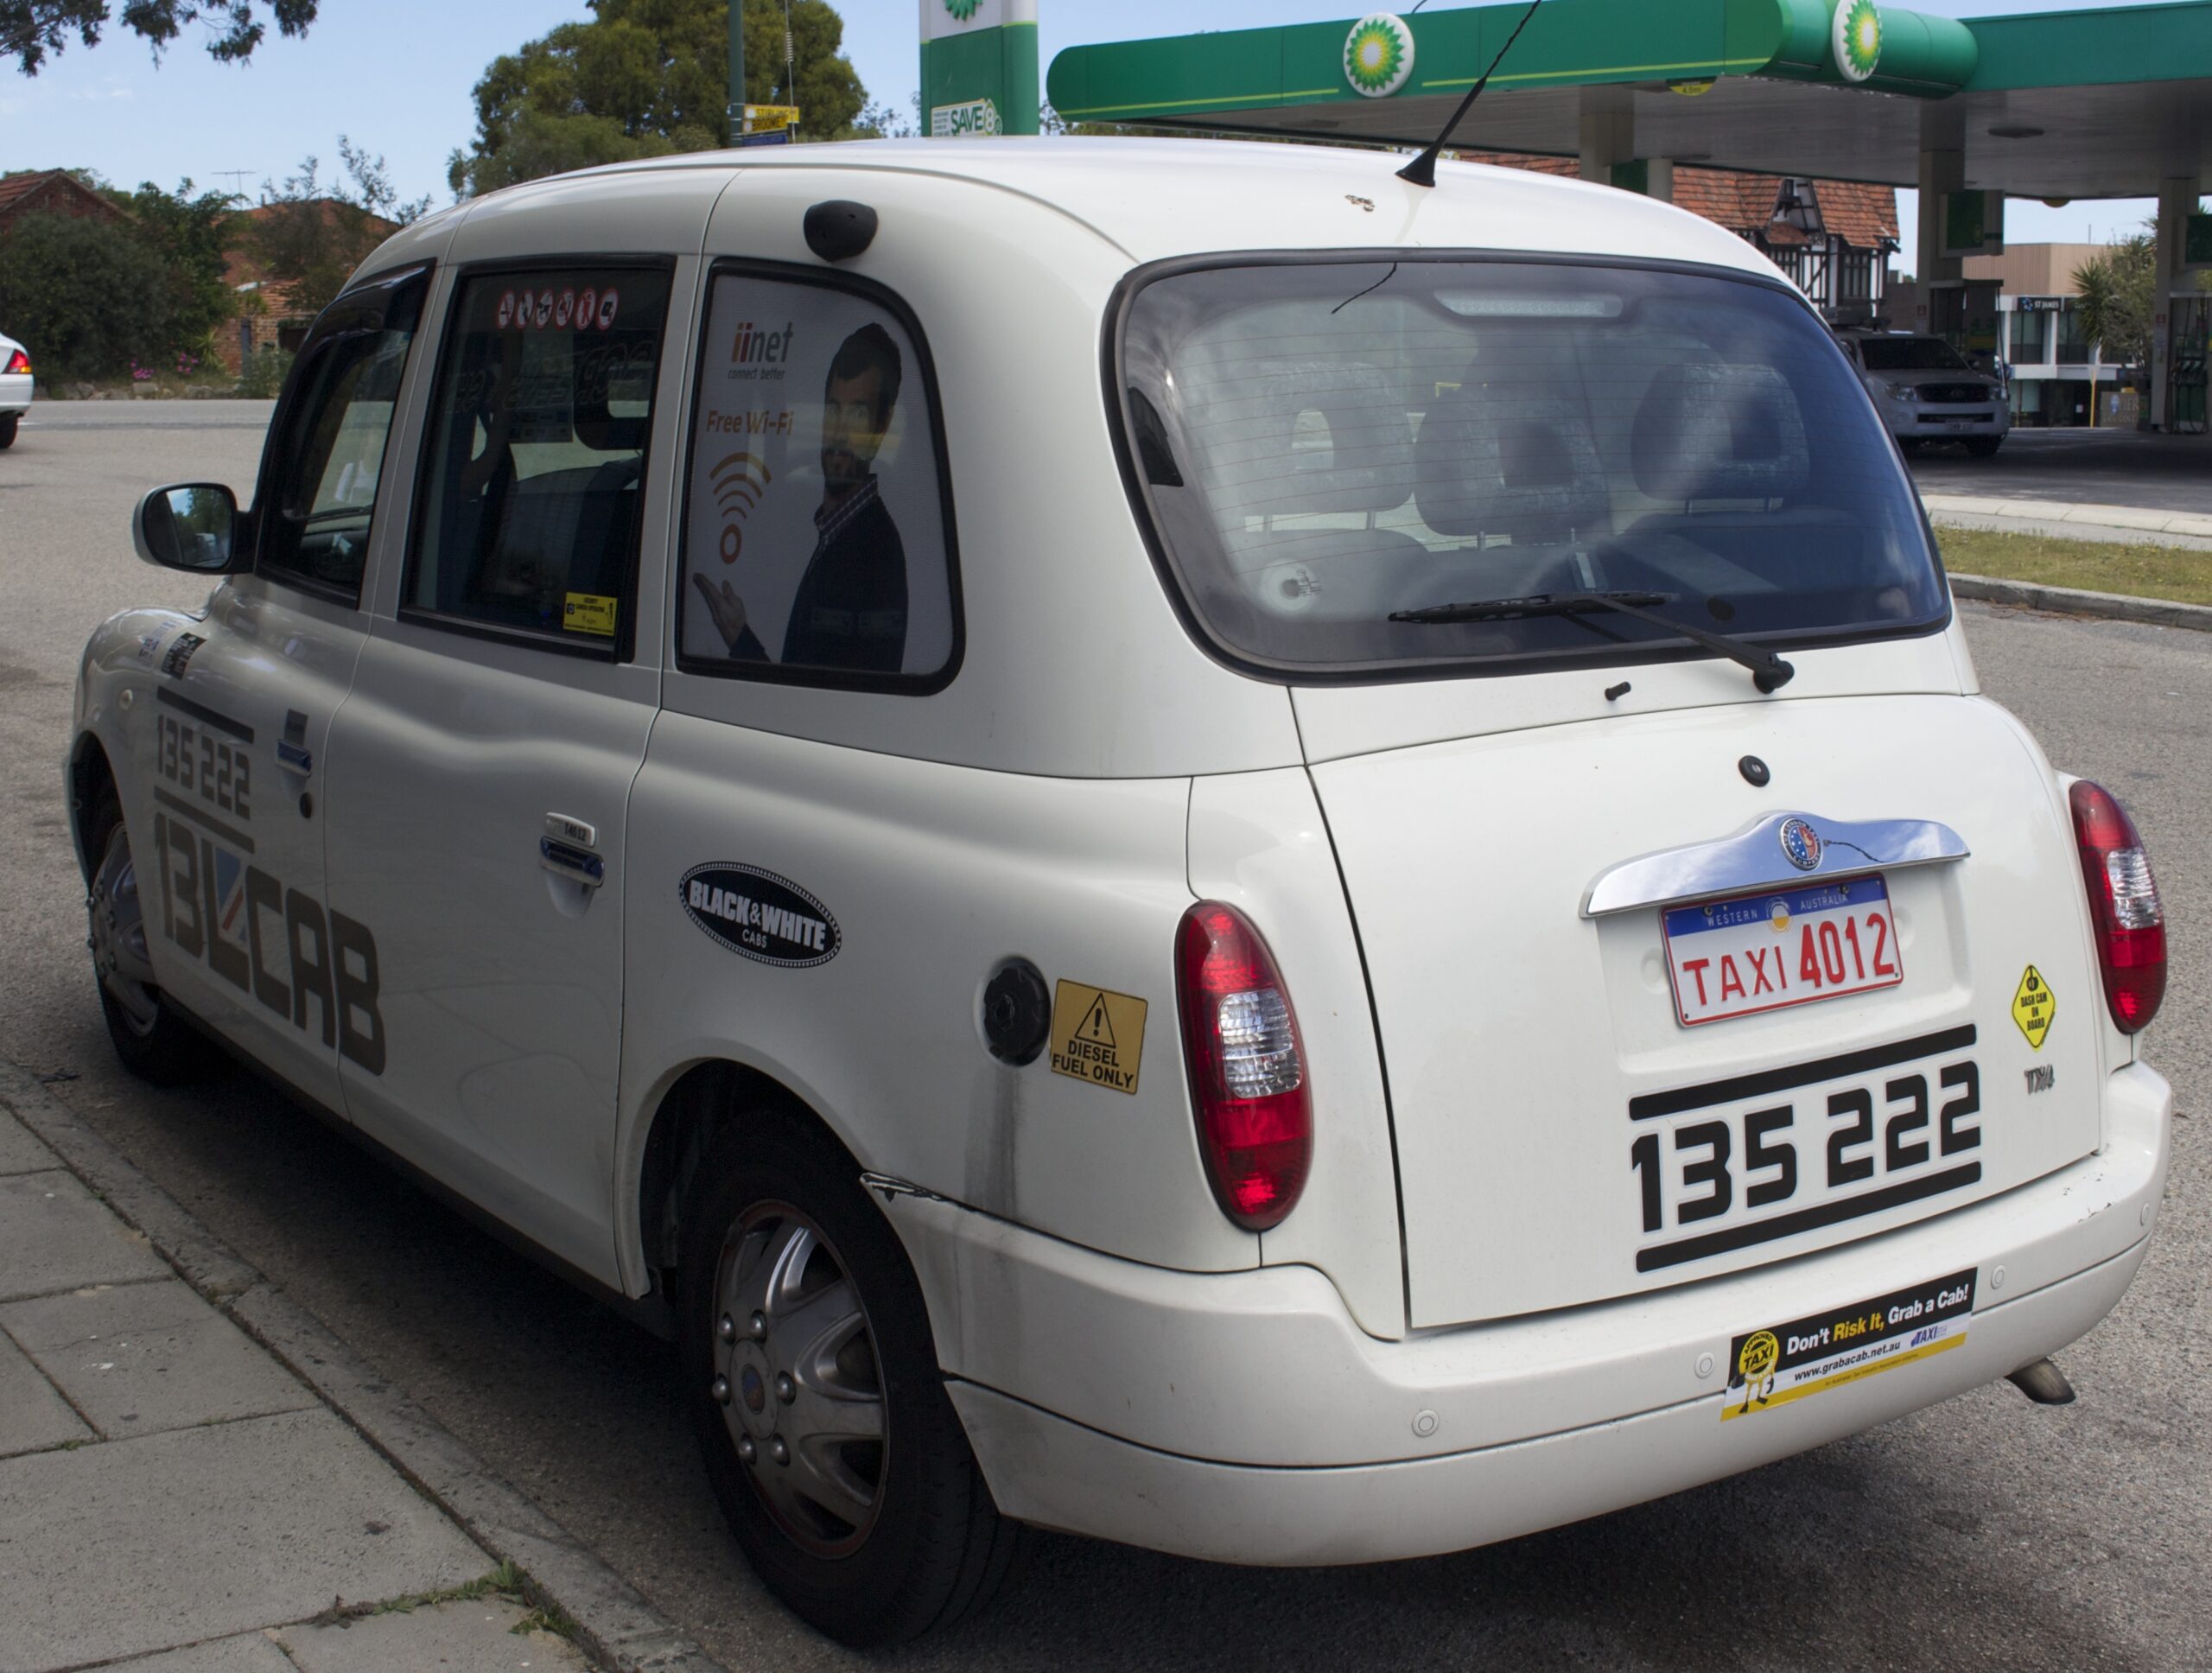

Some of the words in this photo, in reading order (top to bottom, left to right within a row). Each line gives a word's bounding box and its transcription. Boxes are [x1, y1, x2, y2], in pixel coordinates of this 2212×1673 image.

[731, 321, 793, 363] iinet
[728, 367, 757, 380] connect
[760, 367, 785, 380] better
[706, 410, 741, 434] Free
[747, 411, 794, 436] Wi-Fi
[156, 713, 194, 790] 135
[200, 735, 251, 821] 222
[1707, 909, 1758, 926] WESTERN
[1800, 894, 1848, 911] AUSTRALIA
[742, 927, 767, 949] CABS
[1682, 945, 1788, 1006] TAXI
[1800, 913, 1894, 988] 4012
[2020, 996, 2036, 1008] DASH
[2036, 992, 2047, 1003] CAM
[2031, 1007, 2039, 1018] ON
[2027, 1017, 2045, 1031] BOARD
[1068, 1040, 1120, 1067] DIESEL
[1052, 1053, 1089, 1077] FUEL
[1092, 1065, 1134, 1088] ONLY
[1630, 1104, 1797, 1233] 135
[1827, 1060, 1980, 1187] 222
[1786, 1328, 1830, 1356] Don't
[1833, 1316, 1866, 1342] Risk
[1870, 1312, 1885, 1332] It,
[1888, 1301, 1923, 1325] Grab
[1925, 1300, 1934, 1312] a
[1937, 1283, 1969, 1310] Cab!
[1744, 1333, 1773, 1354] APPROVED
[1743, 1344, 1774, 1371] TAXI
[1794, 1340, 1901, 1382] www.grabacab.net.au
